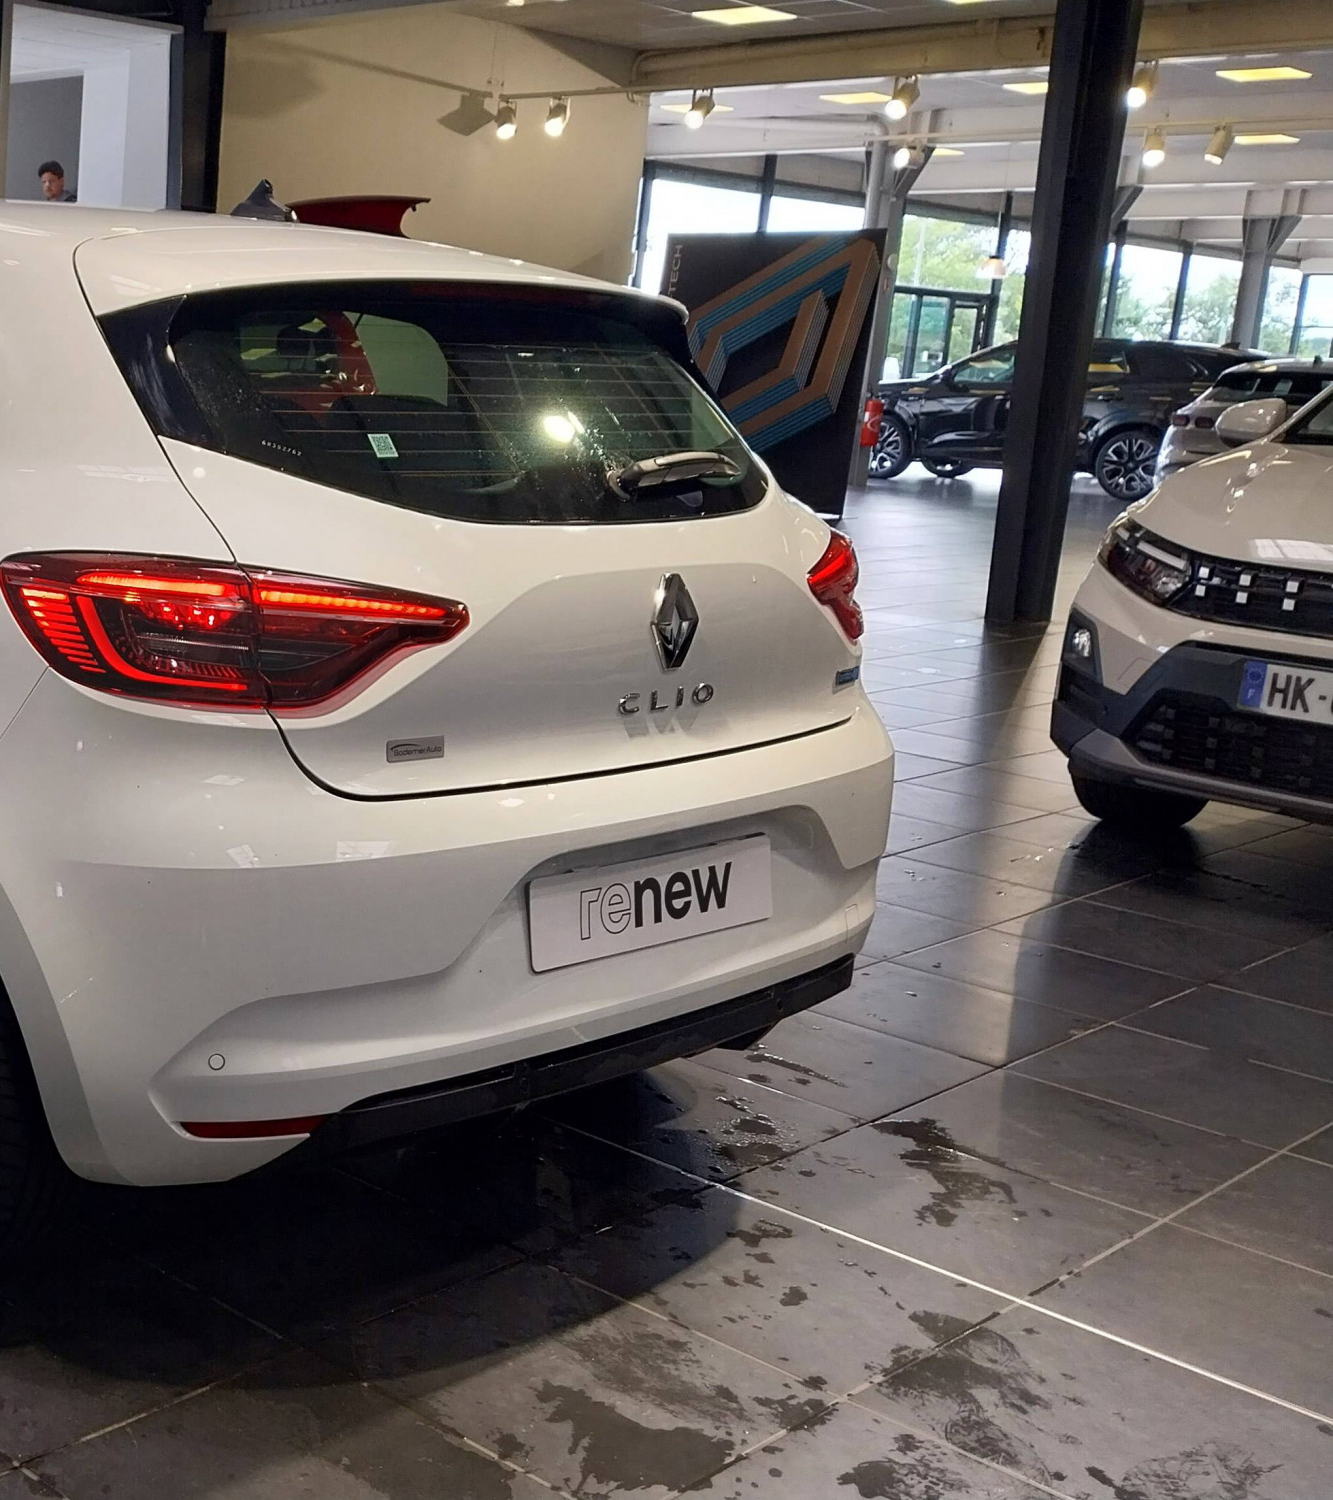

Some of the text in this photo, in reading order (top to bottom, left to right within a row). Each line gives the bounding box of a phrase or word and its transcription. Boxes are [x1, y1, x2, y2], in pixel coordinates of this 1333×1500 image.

[618, 682, 714, 715] CLIO
[1248, 672, 1333, 714] F HK-
[579, 861, 733, 941] renew
